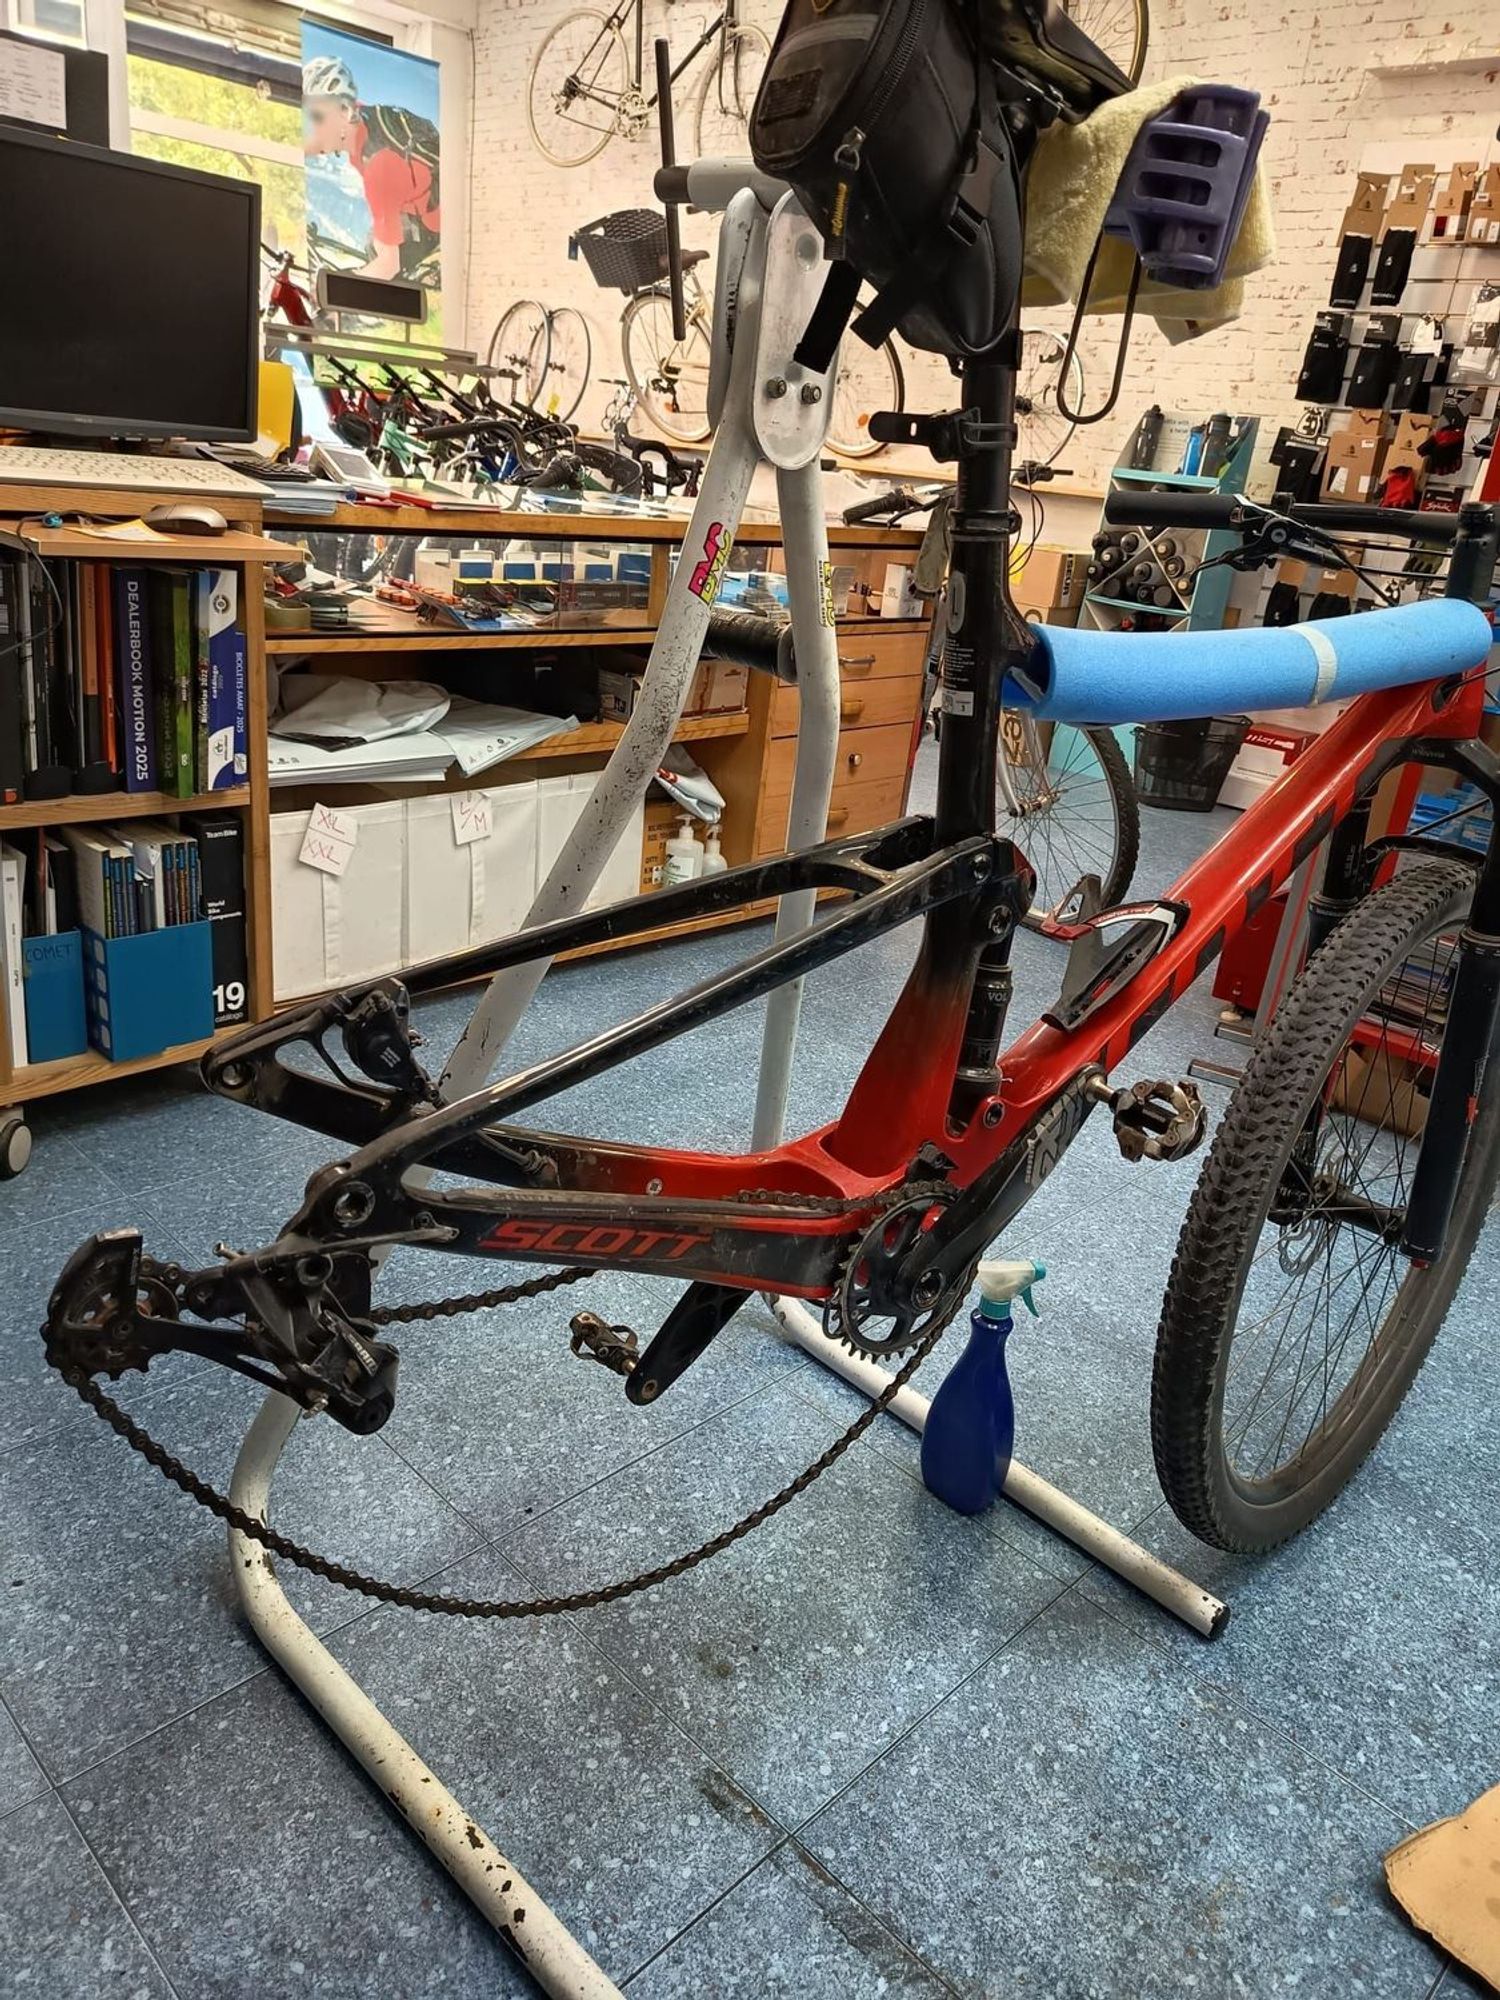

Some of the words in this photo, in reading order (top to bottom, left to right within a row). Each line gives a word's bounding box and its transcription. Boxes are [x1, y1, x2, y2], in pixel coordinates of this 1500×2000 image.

[127, 581, 142, 682] DEALERBOOK
[235, 652, 243, 689] BICICLETES
[131, 686, 146, 742] MOTION
[136, 745, 148, 780] 2025
[302, 838, 340, 866] XXL
[212, 982, 245, 1012] 19
[479, 1219, 712, 1259] SCOTT
